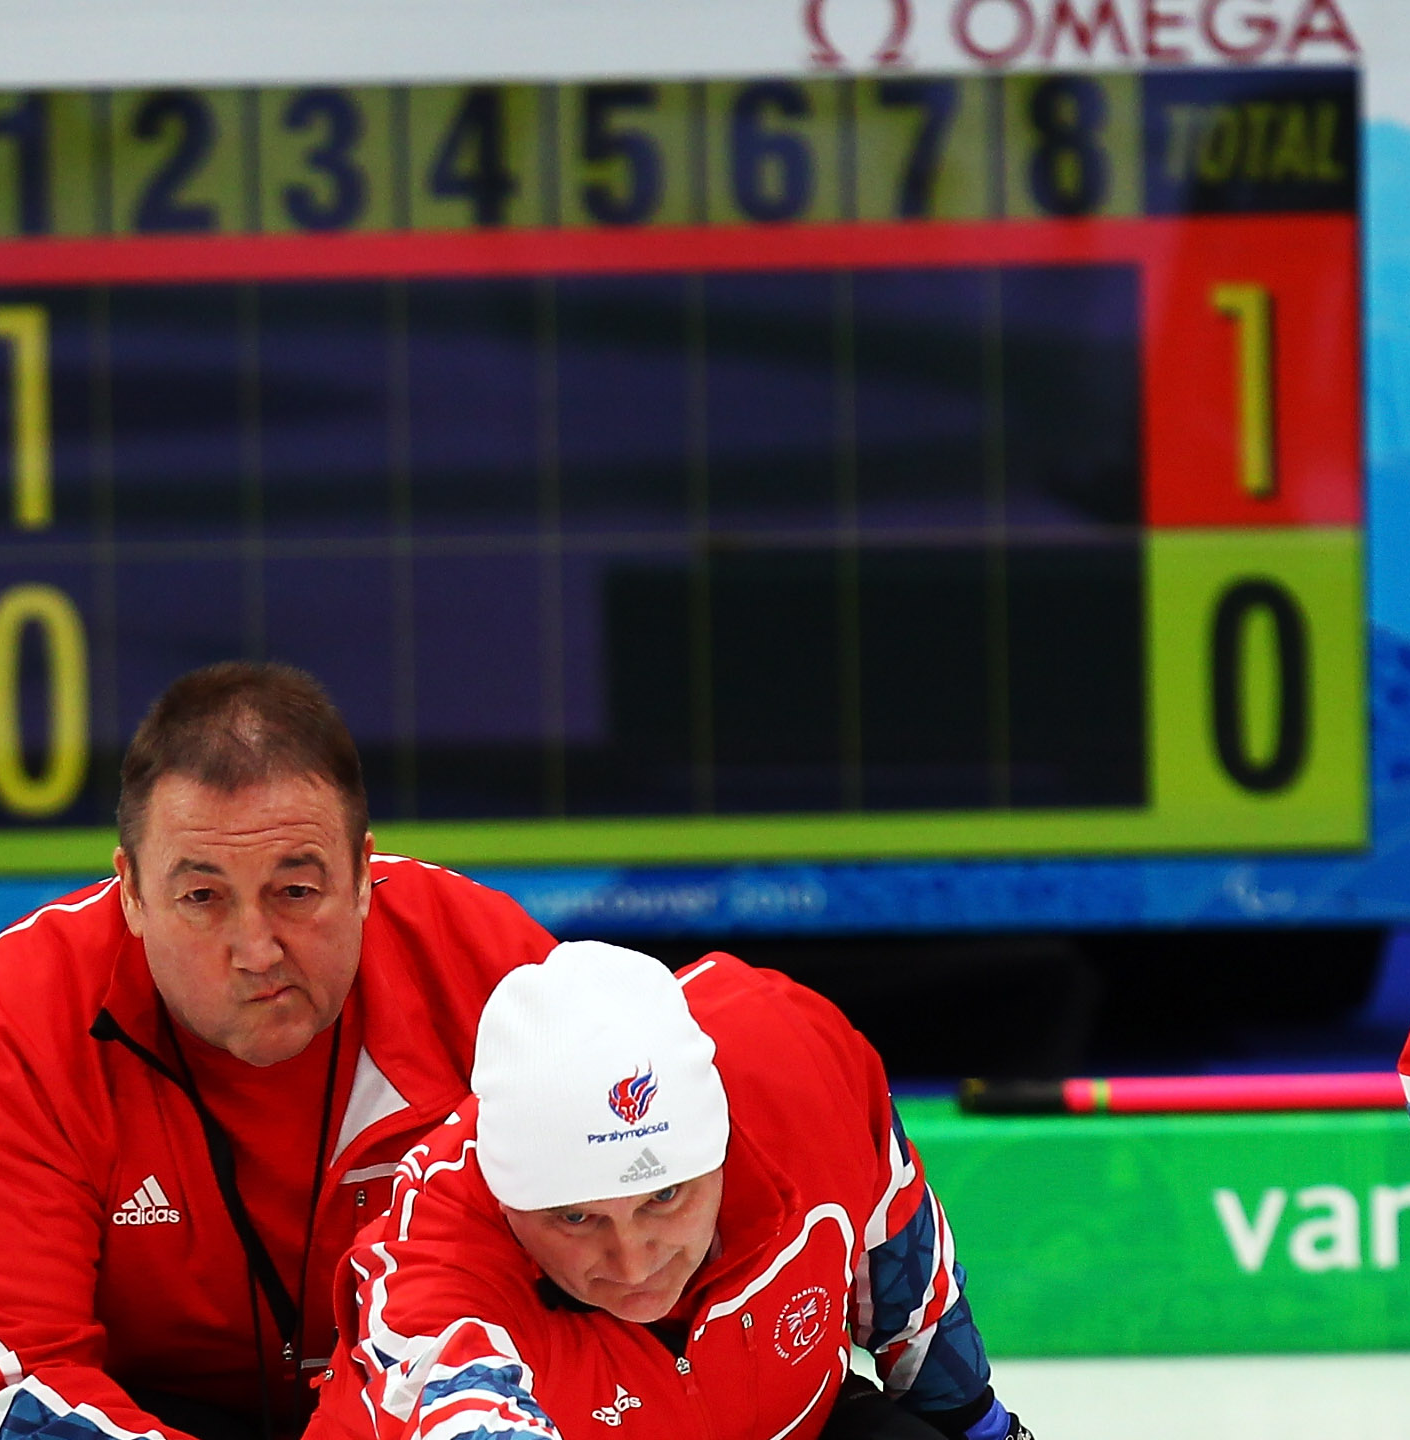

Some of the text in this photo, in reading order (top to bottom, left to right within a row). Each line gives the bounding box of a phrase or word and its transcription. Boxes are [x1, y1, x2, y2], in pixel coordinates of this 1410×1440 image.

[952, 0, 1361, 62] OMEGA
[131, 88, 219, 235] 2
[280, 86, 369, 235] 3
[426, 83, 518, 231] 4
[579, 82, 665, 228] 5
[730, 78, 815, 223] 6
[877, 78, 961, 221] 7
[1029, 75, 1111, 217] 8
[1165, 103, 1347, 182] TOTAL
[1209, 281, 1280, 498] 1
[1209, 572, 1313, 795] 0
[112, 1205, 181, 1226] adidas
[619, 1165, 668, 1184] adidas
